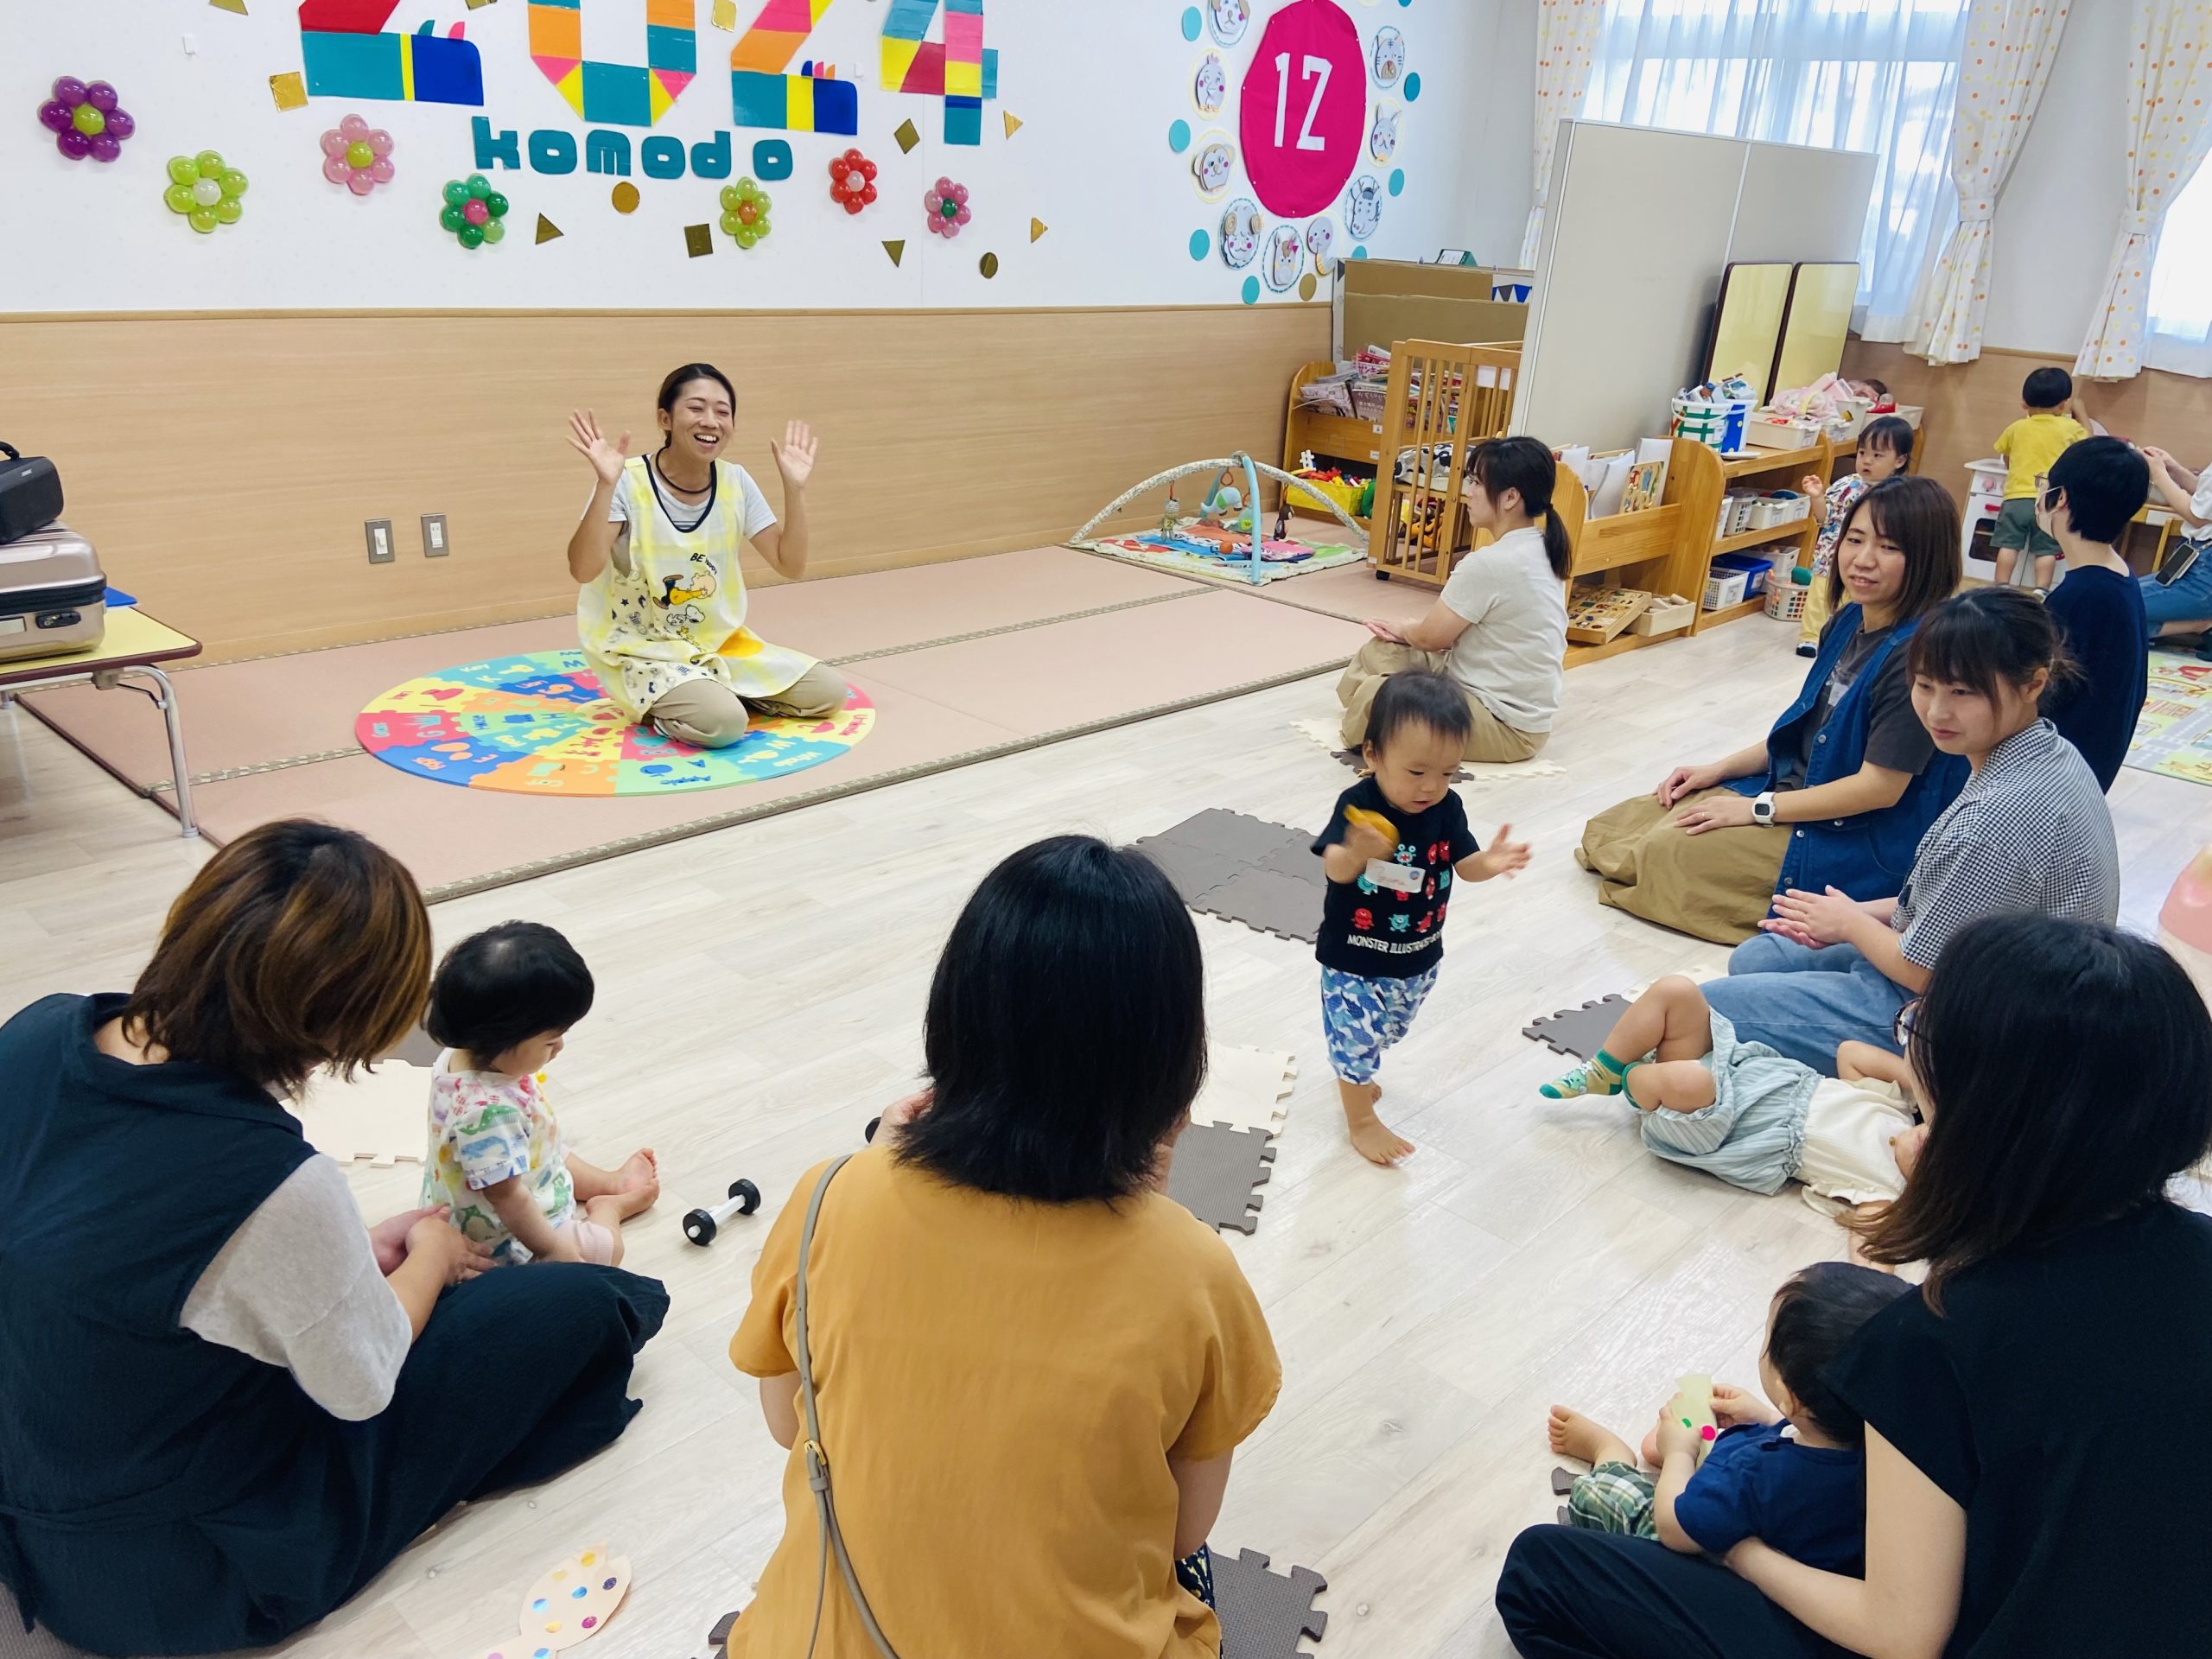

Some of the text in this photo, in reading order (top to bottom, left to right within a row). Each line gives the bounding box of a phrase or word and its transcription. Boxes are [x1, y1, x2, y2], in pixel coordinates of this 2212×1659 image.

[1274, 52, 1333, 151] 12
[472, 115, 794, 181] komodo
[690, 552, 706, 563] BE
[459, 664, 491, 672] Key
[686, 760, 706, 768] A
[772, 751, 823, 767] Whale
[660, 775, 711, 785] Apple
[1346, 934, 1389, 953] MONSTER
